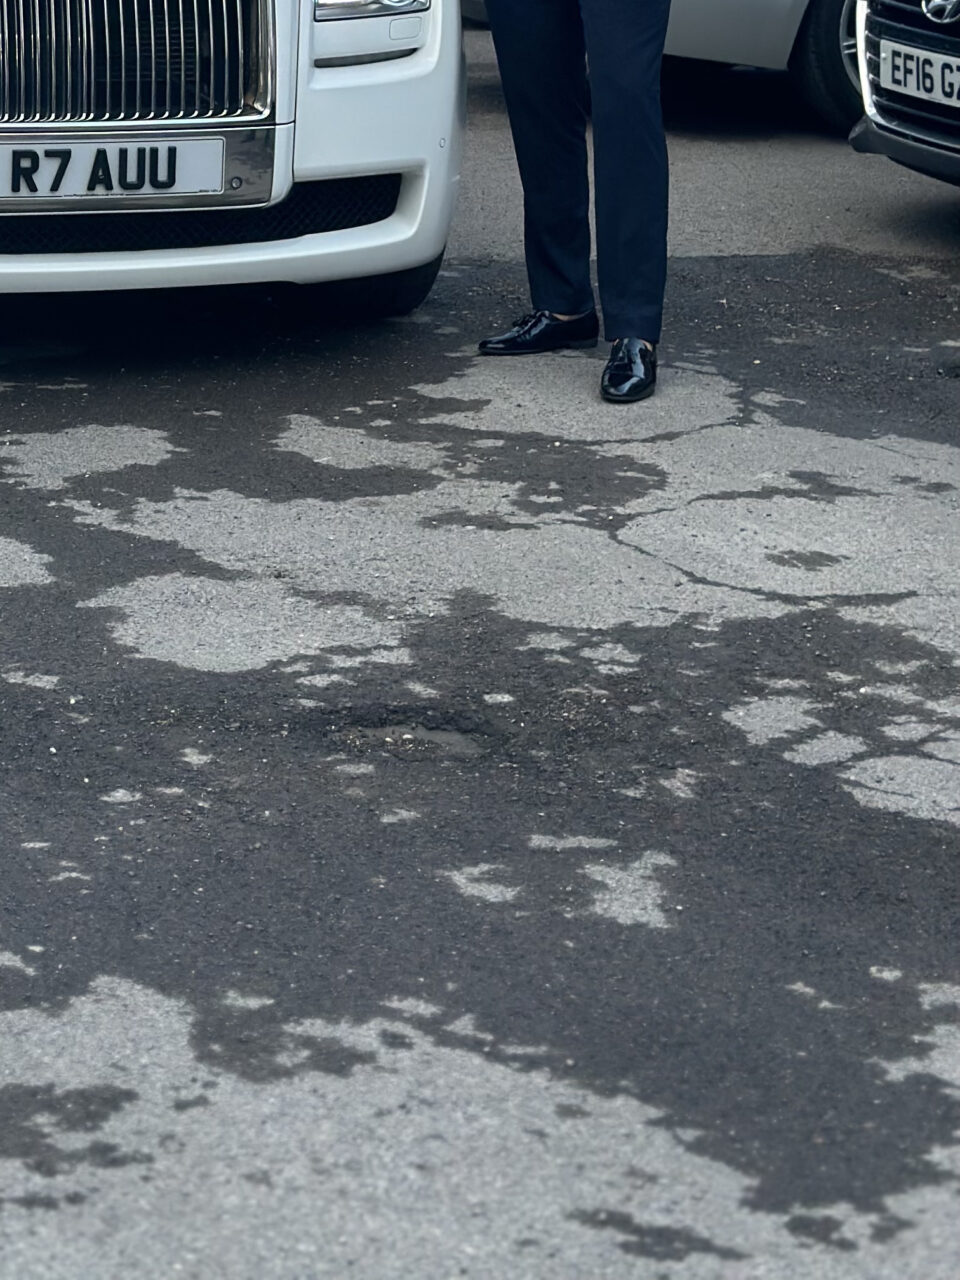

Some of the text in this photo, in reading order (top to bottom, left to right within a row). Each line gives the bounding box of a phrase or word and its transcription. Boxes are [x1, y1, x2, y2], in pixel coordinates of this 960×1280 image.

[892, 50, 934, 94] EF16
[11, 146, 177, 192] R7 AUU
